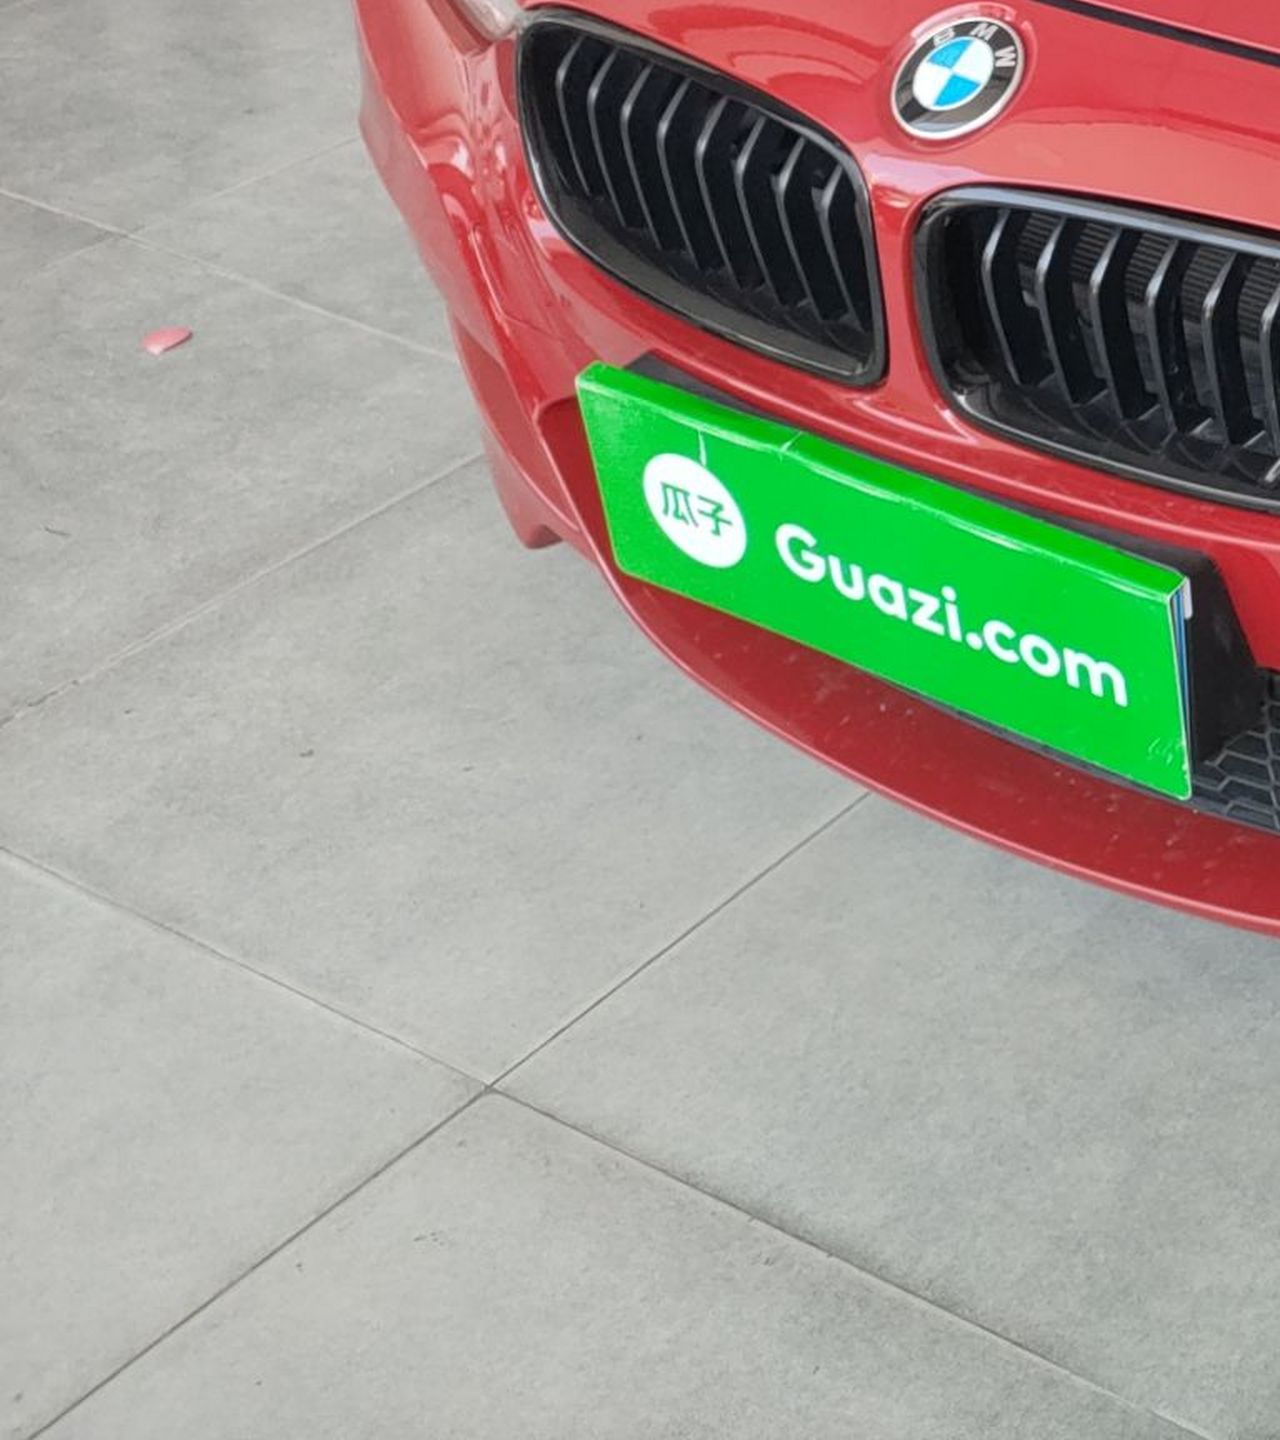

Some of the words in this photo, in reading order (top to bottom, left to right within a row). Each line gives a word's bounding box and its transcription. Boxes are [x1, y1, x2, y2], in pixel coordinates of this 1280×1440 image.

[933, 23, 1017, 67] BMW
[660, 481, 733, 536] 瓜子
[775, 522, 1128, 708] Guazi.com
